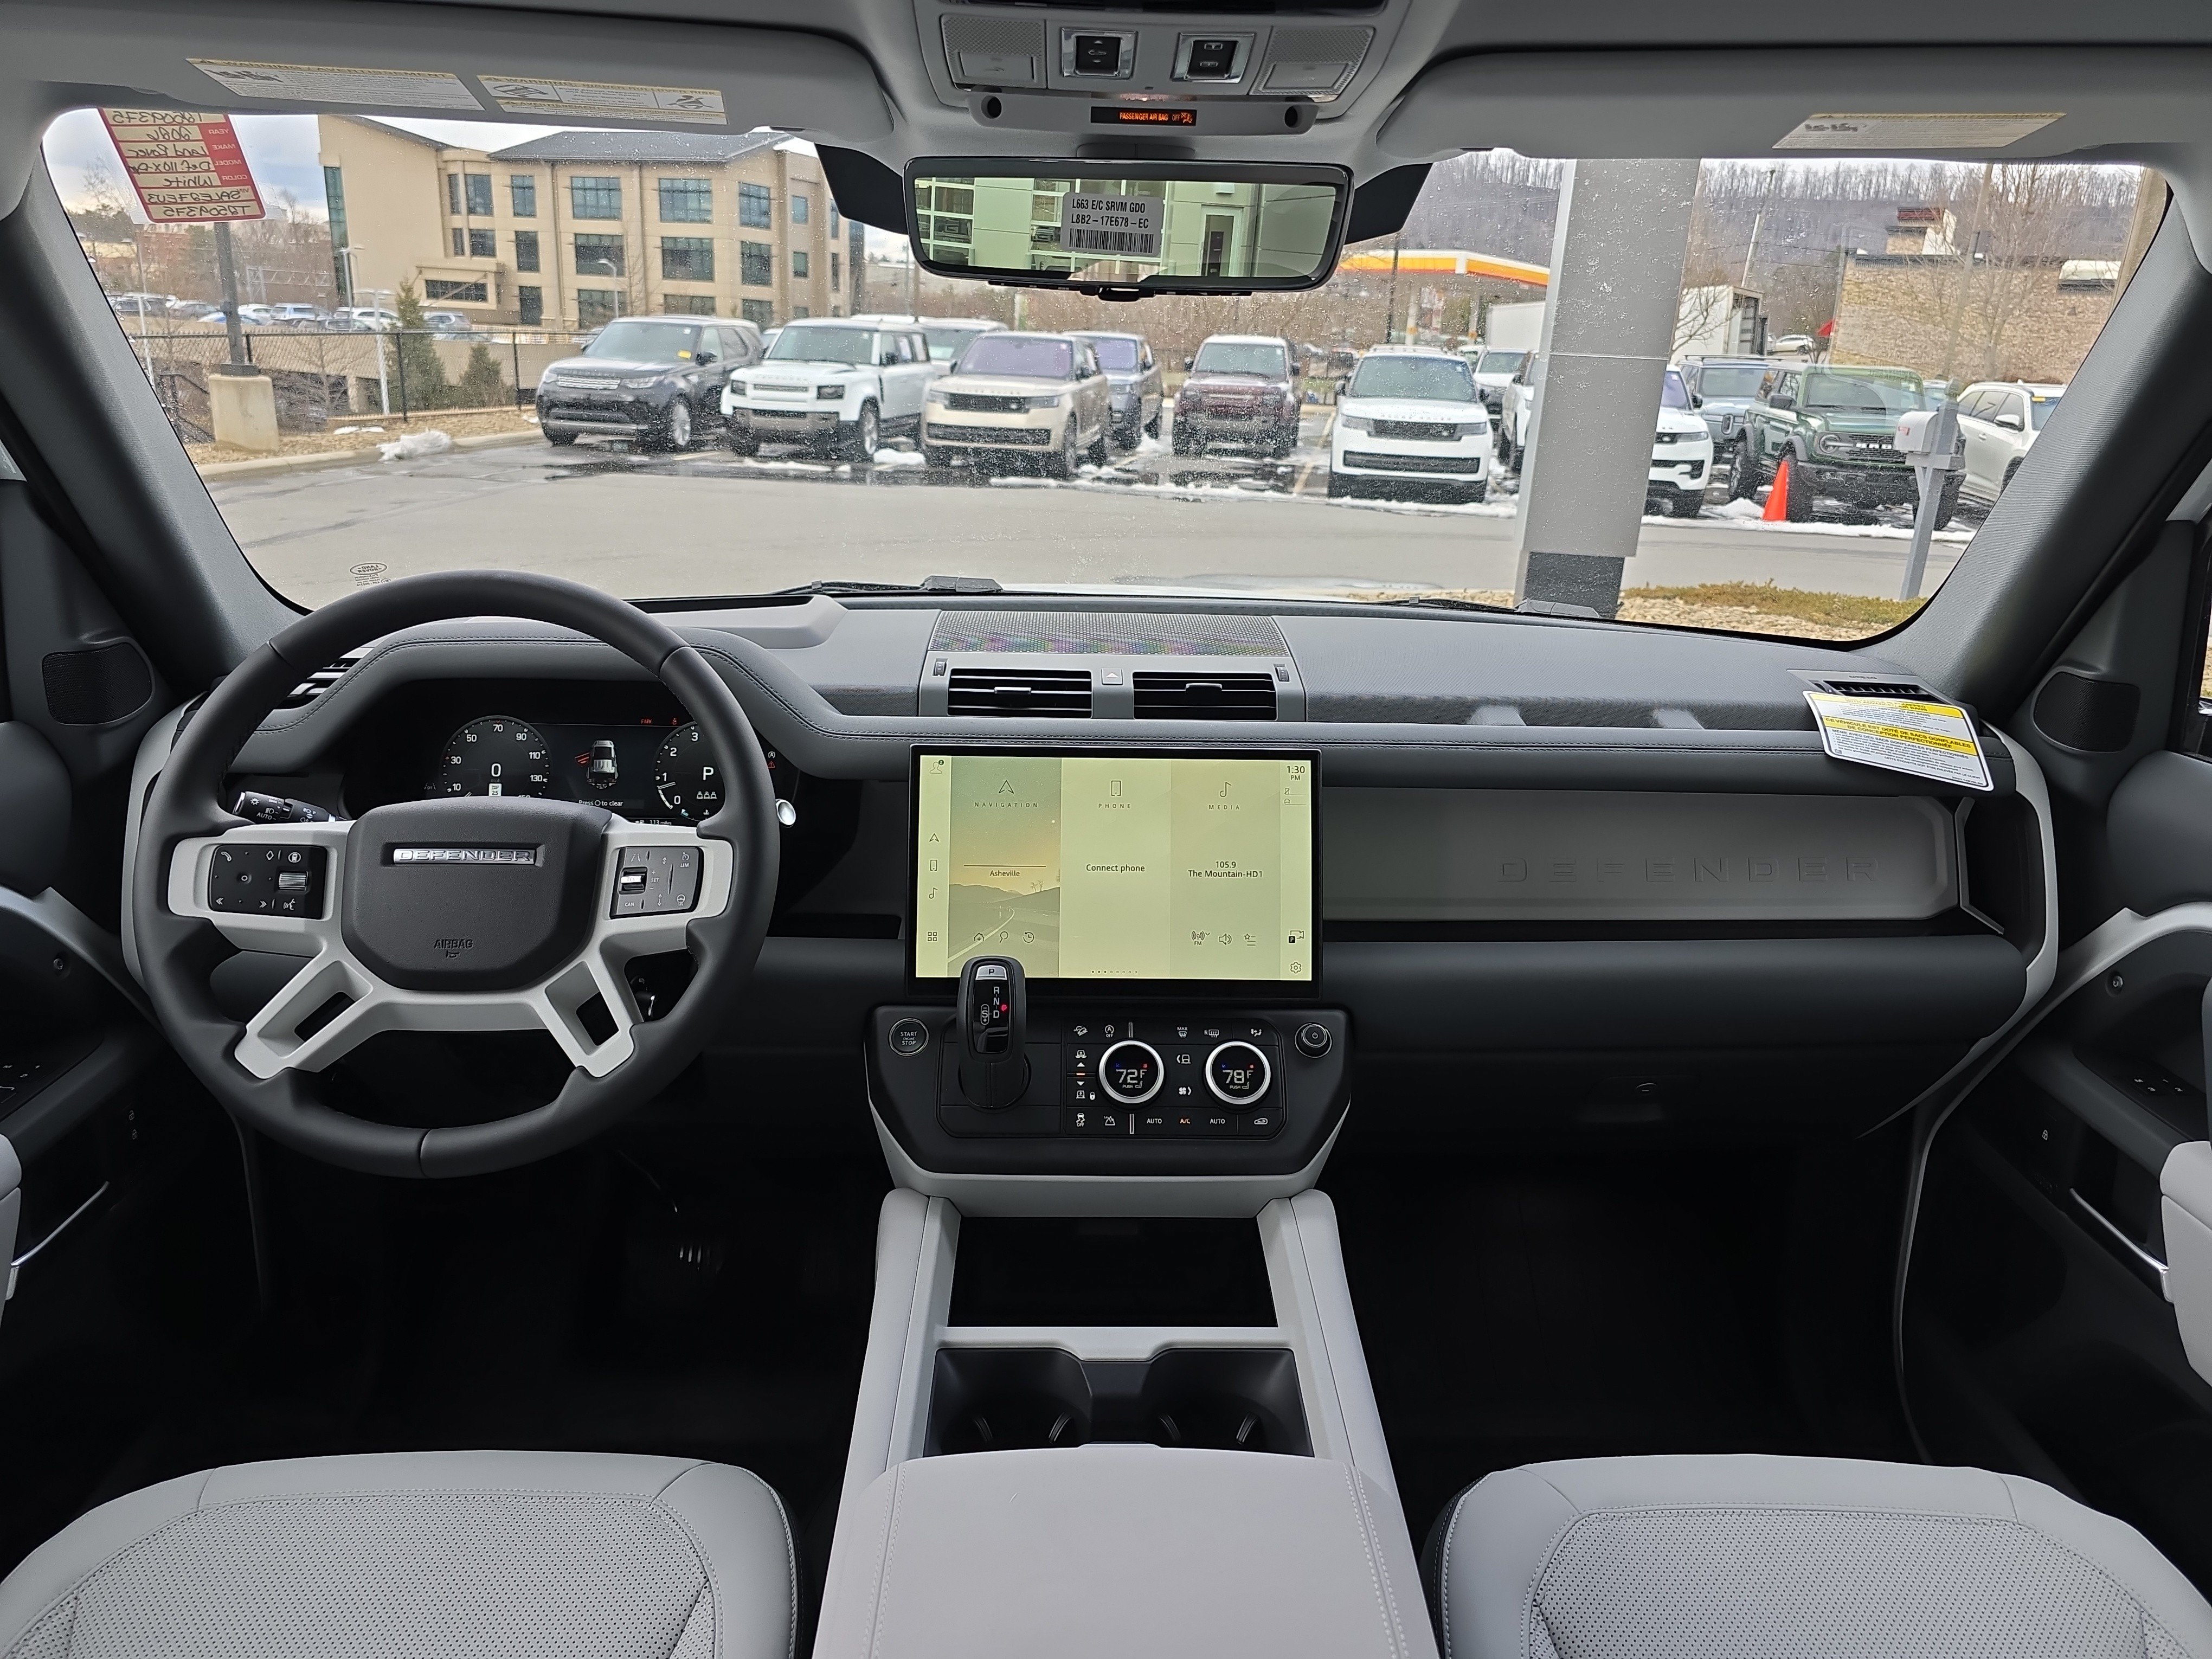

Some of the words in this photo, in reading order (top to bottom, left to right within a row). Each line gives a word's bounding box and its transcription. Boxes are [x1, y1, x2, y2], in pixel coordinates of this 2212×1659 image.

[1120, 112, 1148, 120] PASSENGER
[1072, 198, 1089, 210] L663
[1091, 201, 1103, 211] E/C
[1105, 201, 1127, 213] SRVM
[1129, 202, 1146, 214] GDO
[493, 724, 503, 732] 70
[691, 732, 698, 741] 3
[1834, 718, 1867, 728] VÉHICULE
[1927, 736, 1971, 748] GONFLABLES
[1856, 726, 1899, 737] CONCEPTION
[1899, 735, 1953, 749] PERFECTIONNÉE
[670, 747, 677, 756] 2
[491, 763, 501, 777] 0
[703, 767, 713, 780] P
[1287, 766, 1305, 774] 1:30
[662, 773, 667, 781] 1
[674, 796, 681, 805] 0
[256, 812, 273, 820] AUTO
[398, 850, 531, 861] DEFENDER
[1086, 864, 1118, 872] Connect
[1120, 864, 1145, 873] phone
[1497, 857, 1879, 882] DEFENDER
[1188, 870, 1202, 878] The
[1204, 869, 1263, 878] Mountain-HD1
[434, 939, 473, 949] AIRBAG
[993, 986, 1000, 994] R
[982, 1010, 988, 1018] S
[993, 1010, 1000, 1019] D
